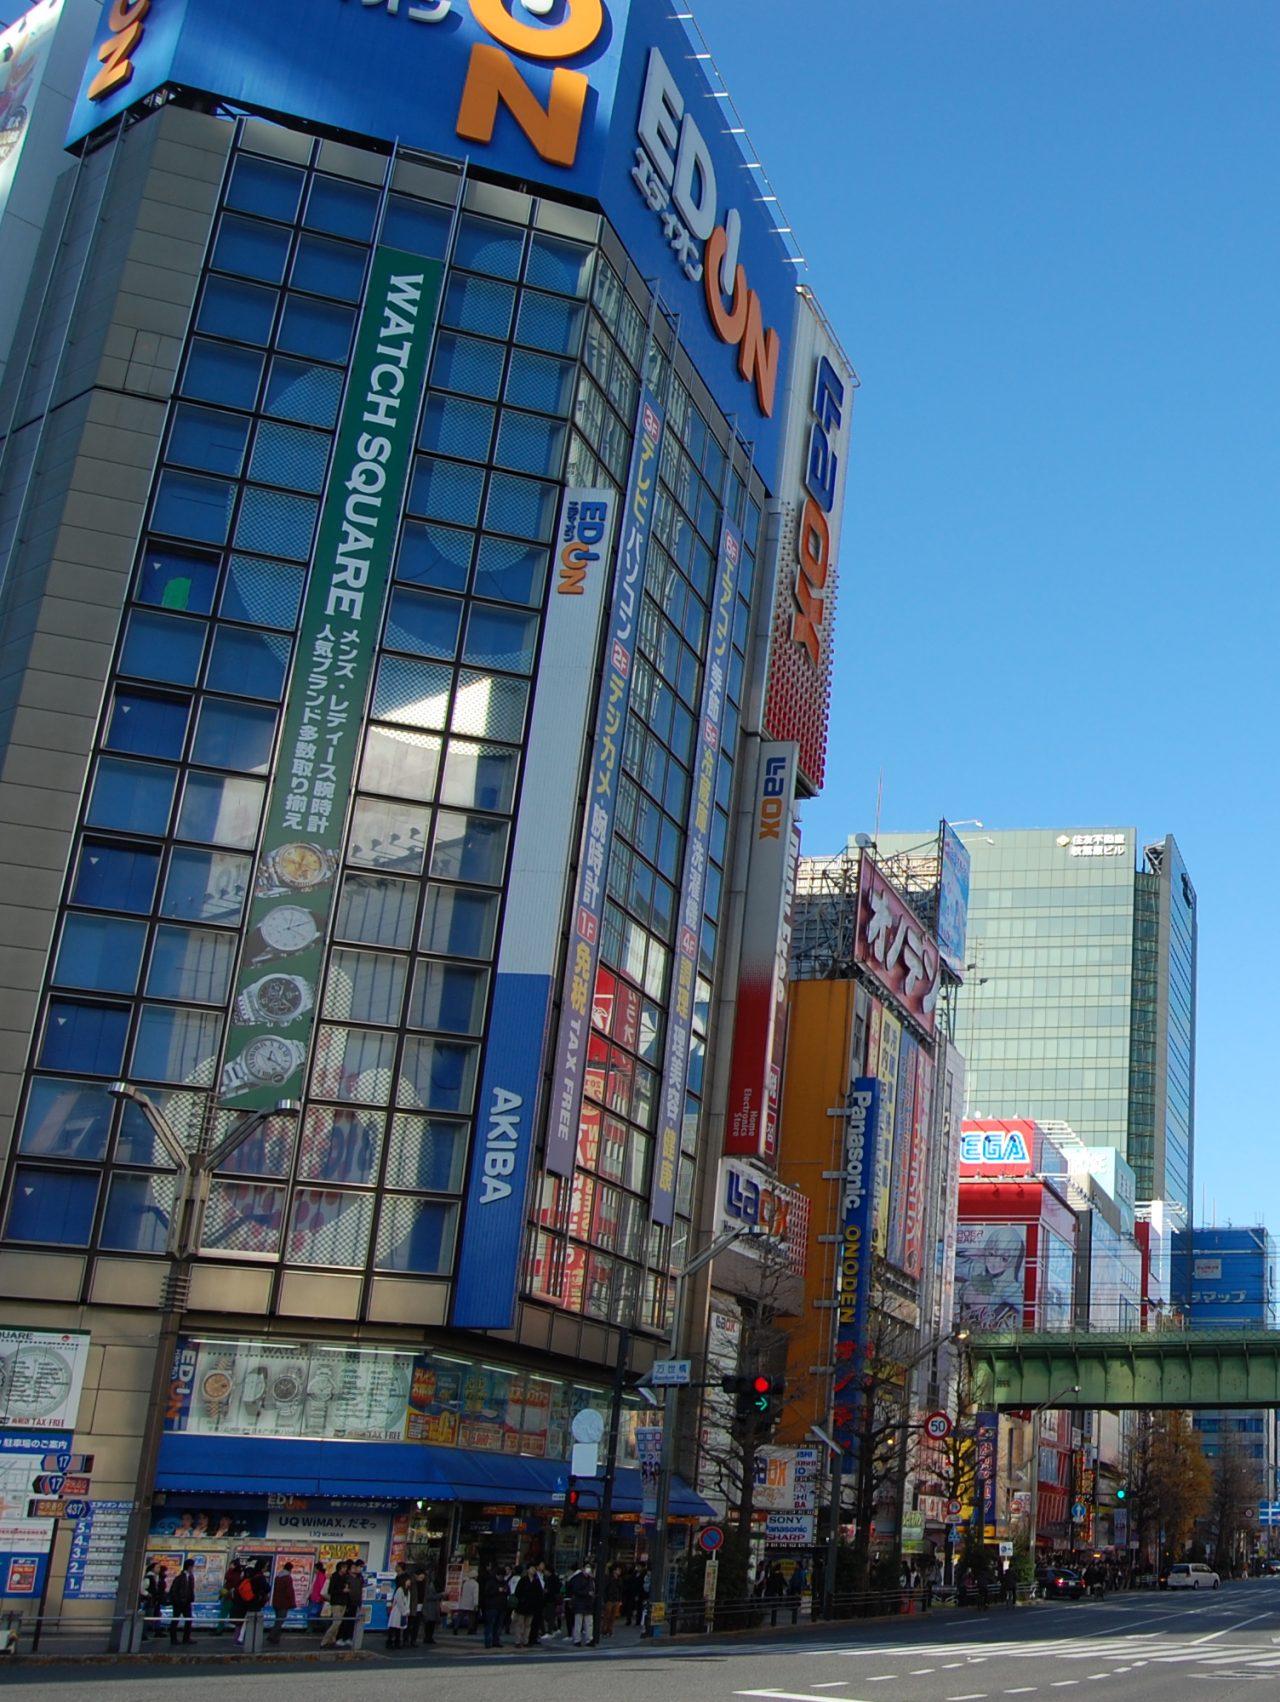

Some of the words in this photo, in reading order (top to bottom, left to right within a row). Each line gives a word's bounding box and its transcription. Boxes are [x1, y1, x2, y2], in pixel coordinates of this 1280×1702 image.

[363, 274, 424, 428] WATCH
[325, 434, 391, 620] SQUARE
[583, 669, 625, 913] デジカメ・腕時計
[564, 1013, 582, 1074] TAX
[555, 1075, 575, 1143] FREE
[479, 1087, 522, 1204] AKIBA
[845, 1091, 873, 1210] Panasonic
[960, 1131, 1030, 1164] EGA
[839, 1225, 862, 1324] ONODEN
[656, 1363, 688, 1374] 万世橋
[931, 1420, 946, 1432] 50
[59, 1456, 69, 1468] 17
[51, 1477, 62, 1489] 17
[67, 1503, 82, 1515] 437
[279, 1517, 300, 1528] UQ
[769, 1516, 803, 1524] SONY
[766, 1533, 806, 1542] SHARP
